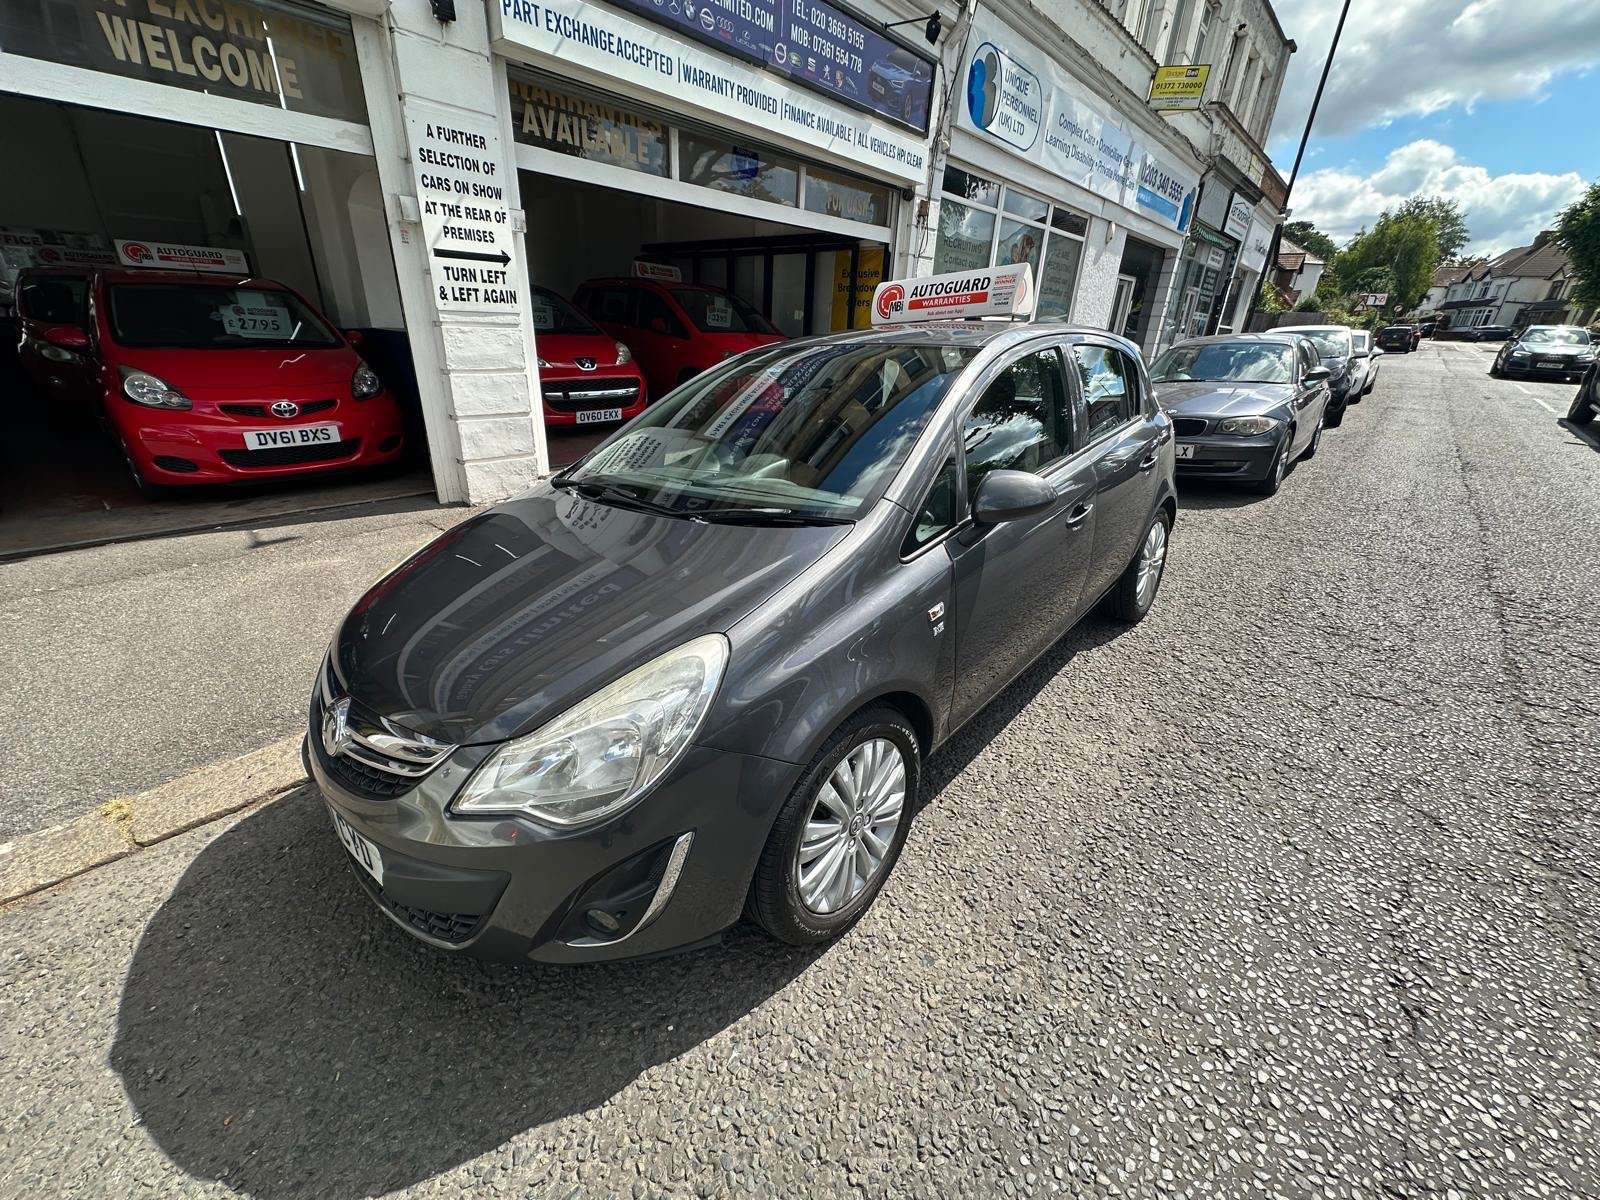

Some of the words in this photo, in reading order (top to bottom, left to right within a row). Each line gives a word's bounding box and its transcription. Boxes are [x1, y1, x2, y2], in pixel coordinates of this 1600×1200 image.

[792, 0, 808, 20] TEL:
[811, 7, 826, 29] 020
[847, 27, 865, 50] 5155
[96, 10, 303, 100] WELCOME
[791, 23, 811, 49] MOB:
[812, 35, 835, 59] 07361
[835, 46, 849, 67] 554
[850, 53, 863, 73] 778
[502, 0, 540, 27] PART
[616, 36, 674, 76] ACCEPTED
[682, 62, 735, 99] WARRANTY
[736, 84, 778, 115] PROVIDED
[784, 103, 816, 129] FINANCE
[816, 115, 852, 143] AVAILABLE
[858, 132, 869, 149] ALL
[869, 136, 896, 159] VEHICLES
[906, 152, 923, 170] CLEAR
[1005, 68, 1030, 96] UNIQUE
[1001, 91, 1038, 124] PERSONNEL
[426, 123, 434, 139] A
[436, 125, 487, 150] FURTHER
[522, 102, 650, 165] AVAILABLE
[999, 111, 1013, 133] (UK)
[1012, 119, 1025, 136] LTD
[1059, 113, 1084, 141] Complex
[1083, 128, 1096, 146] Care
[418, 147, 480, 174] SELECTION
[482, 161, 496, 176] OF
[1045, 129, 1071, 159] Learning
[1071, 144, 1095, 171] Disability
[421, 173, 451, 192] CARS
[454, 179, 470, 195] ON
[472, 183, 502, 200] SHOW
[1141, 161, 1159, 188] 0203
[425, 201, 437, 215] AT
[440, 202, 462, 218] THE
[464, 206, 492, 223] REAR
[494, 210, 507, 224] OF
[443, 225, 495, 244] PREMISES
[156, 247, 223, 260] AUTOGUARD
[443, 265, 477, 283] TURN
[480, 269, 507, 285] LEFT
[841, 269, 880, 278] Exusive
[439, 285, 448, 301] &
[451, 286, 479, 303] LEFT
[483, 288, 517, 304] AGAIN
[910, 277, 991, 299] AUTOGUARD
[922, 294, 971, 307] WARRANTIES
[580, 411, 602, 422] OV60
[603, 410, 619, 420] EKX
[255, 430, 297, 446] DV61
[298, 428, 332, 443] BXS
